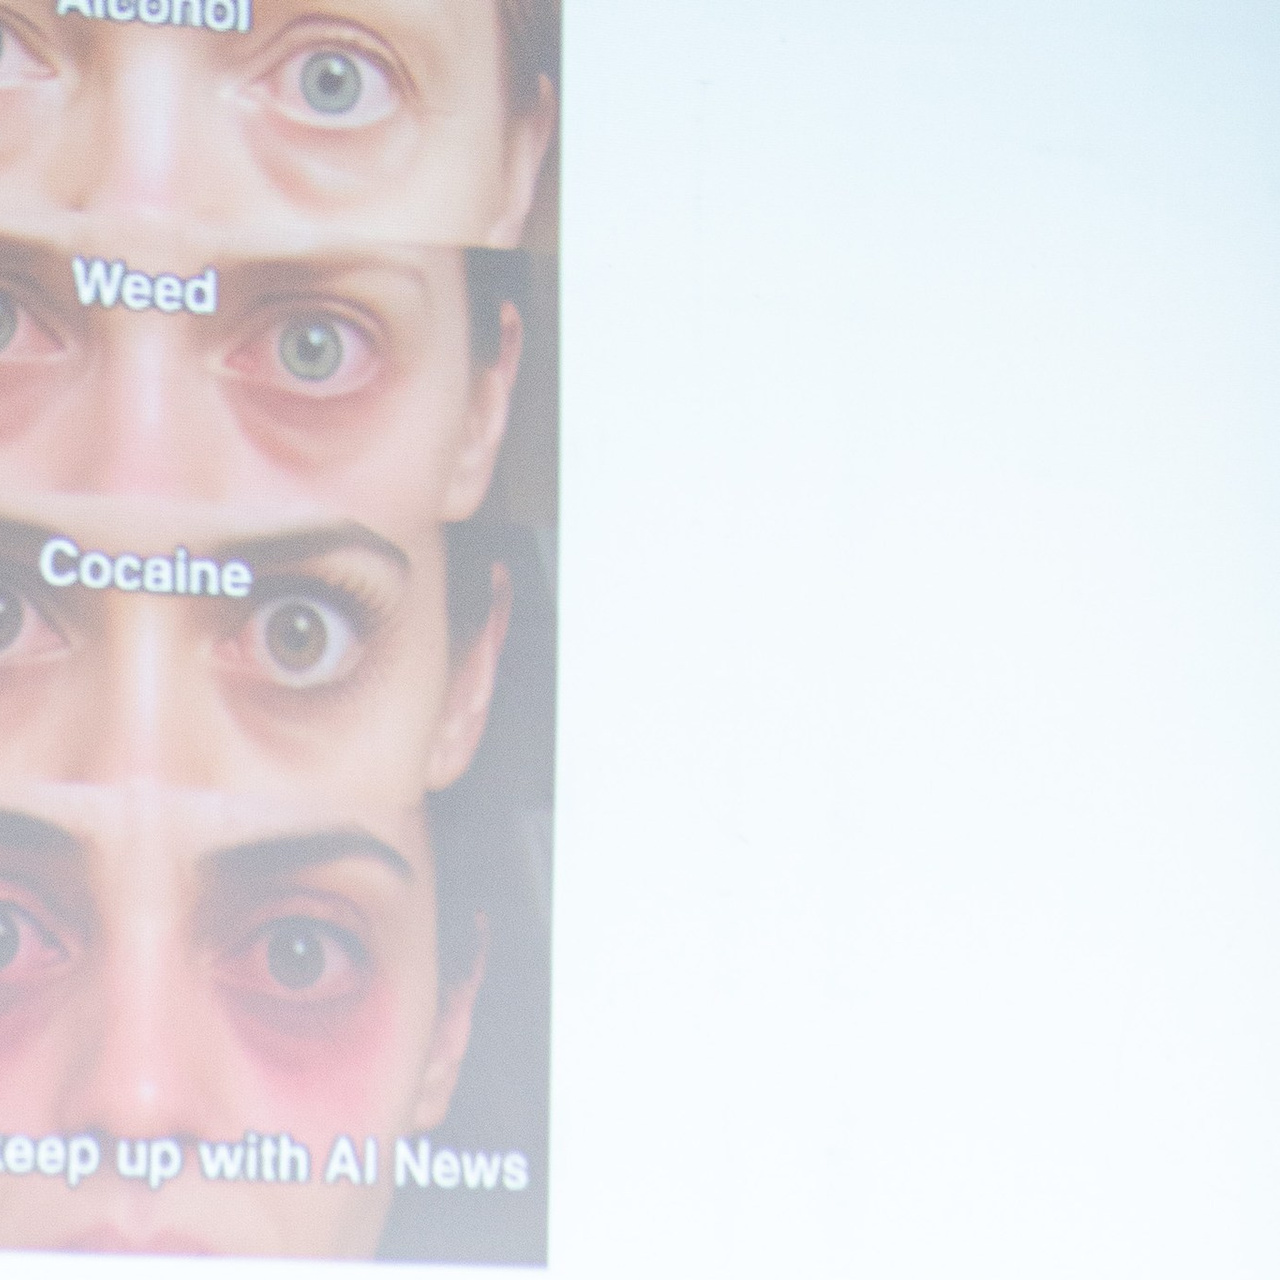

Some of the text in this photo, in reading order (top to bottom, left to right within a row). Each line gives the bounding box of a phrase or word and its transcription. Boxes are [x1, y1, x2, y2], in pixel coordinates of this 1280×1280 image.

[72, 256, 217, 314] Weed
[39, 534, 253, 598] Cocaine
[117, 1136, 183, 1190] up
[199, 1130, 311, 1184] with
[324, 1132, 378, 1186] AI
[394, 1134, 530, 1192] News
